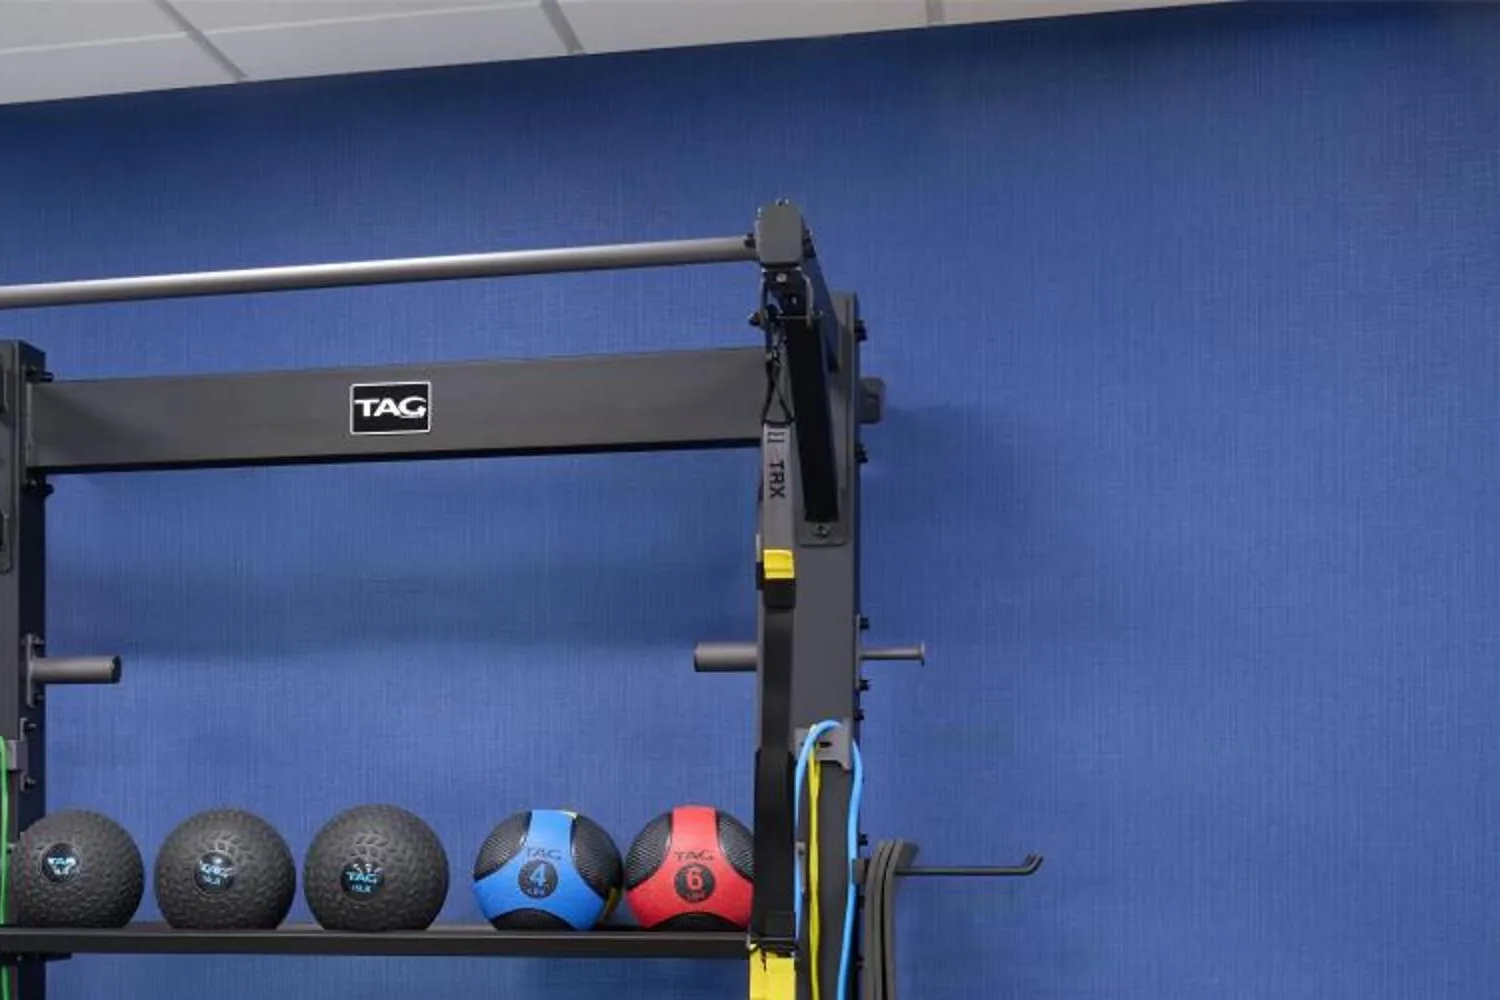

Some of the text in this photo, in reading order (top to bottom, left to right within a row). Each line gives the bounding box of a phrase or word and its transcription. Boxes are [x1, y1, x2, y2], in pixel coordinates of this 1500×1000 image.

[354, 396, 427, 418] TAG
[769, 459, 786, 499] TRX
[530, 863, 548, 887] 4
[687, 867, 704, 890] 6
